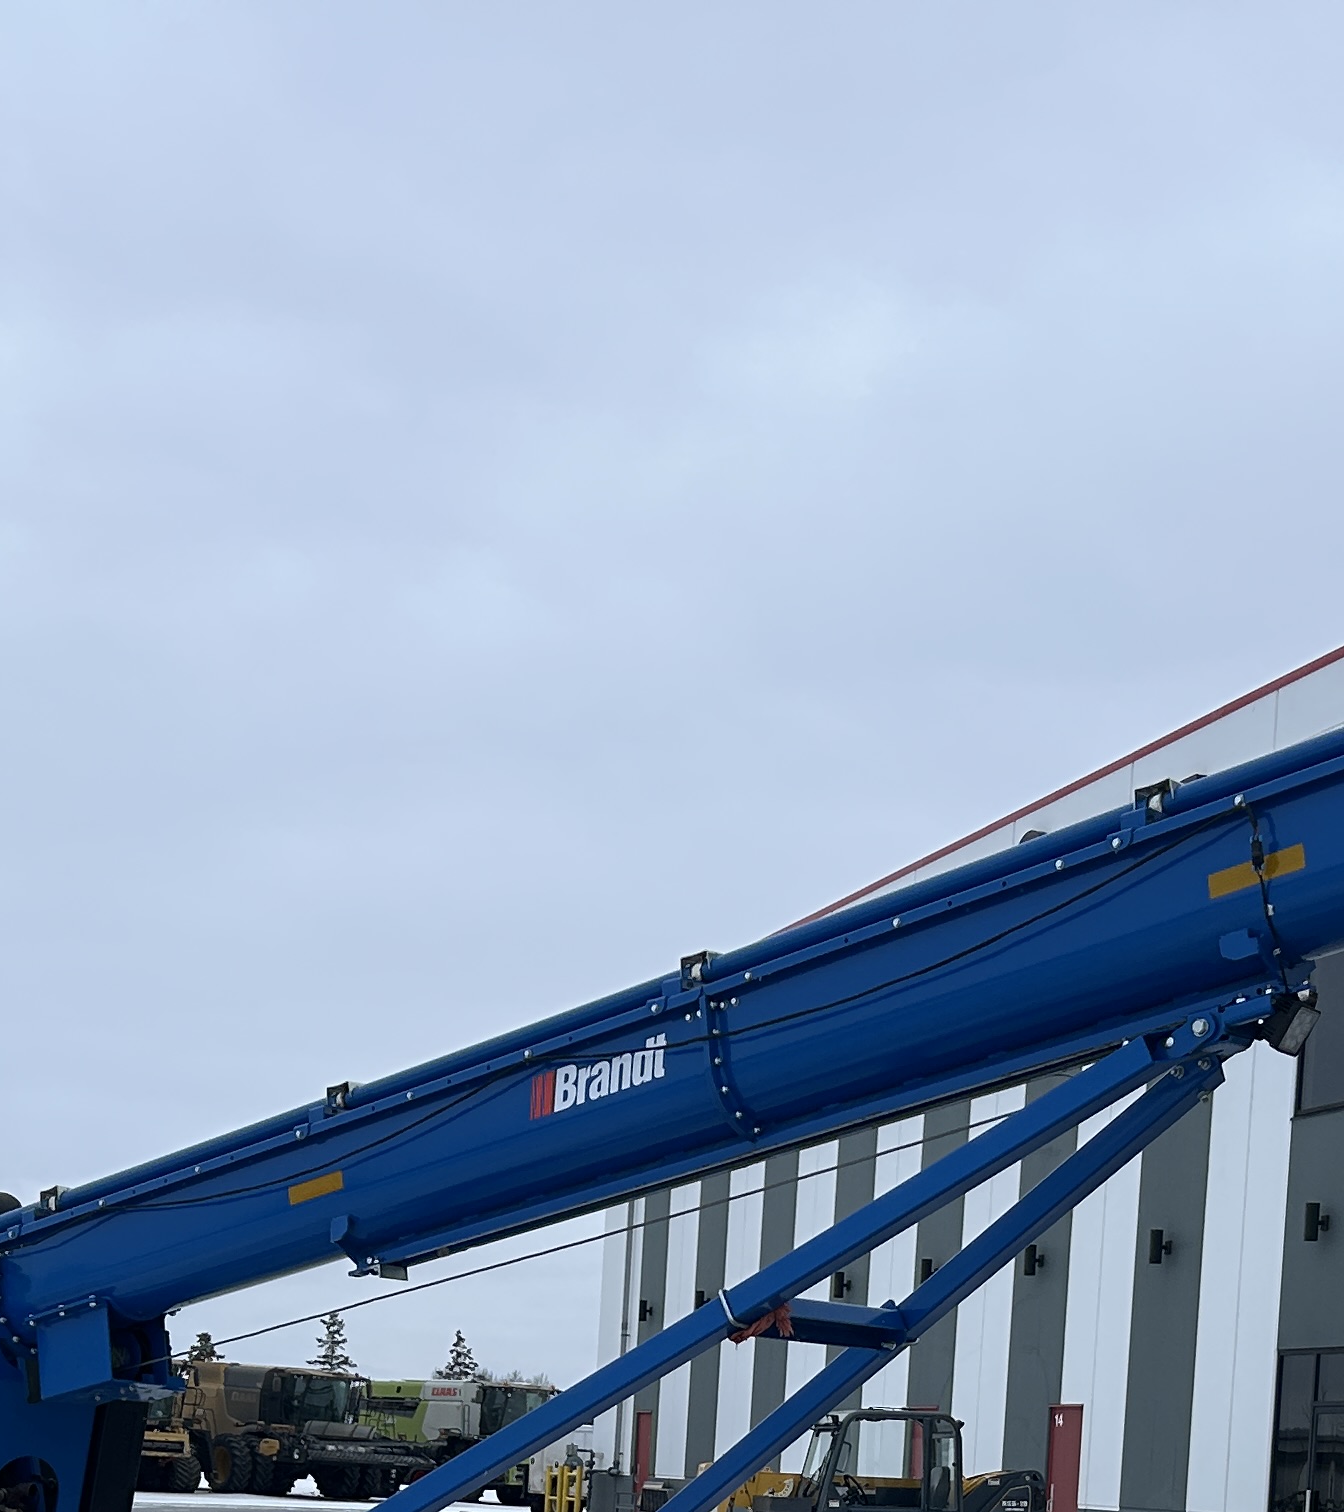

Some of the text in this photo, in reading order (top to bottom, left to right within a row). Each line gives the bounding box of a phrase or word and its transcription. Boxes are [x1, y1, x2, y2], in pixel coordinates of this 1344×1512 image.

[553, 1032, 668, 1113] Brandt
[431, 1387, 458, 1396] CLAAS
[1054, 1412, 1064, 1428] 14
